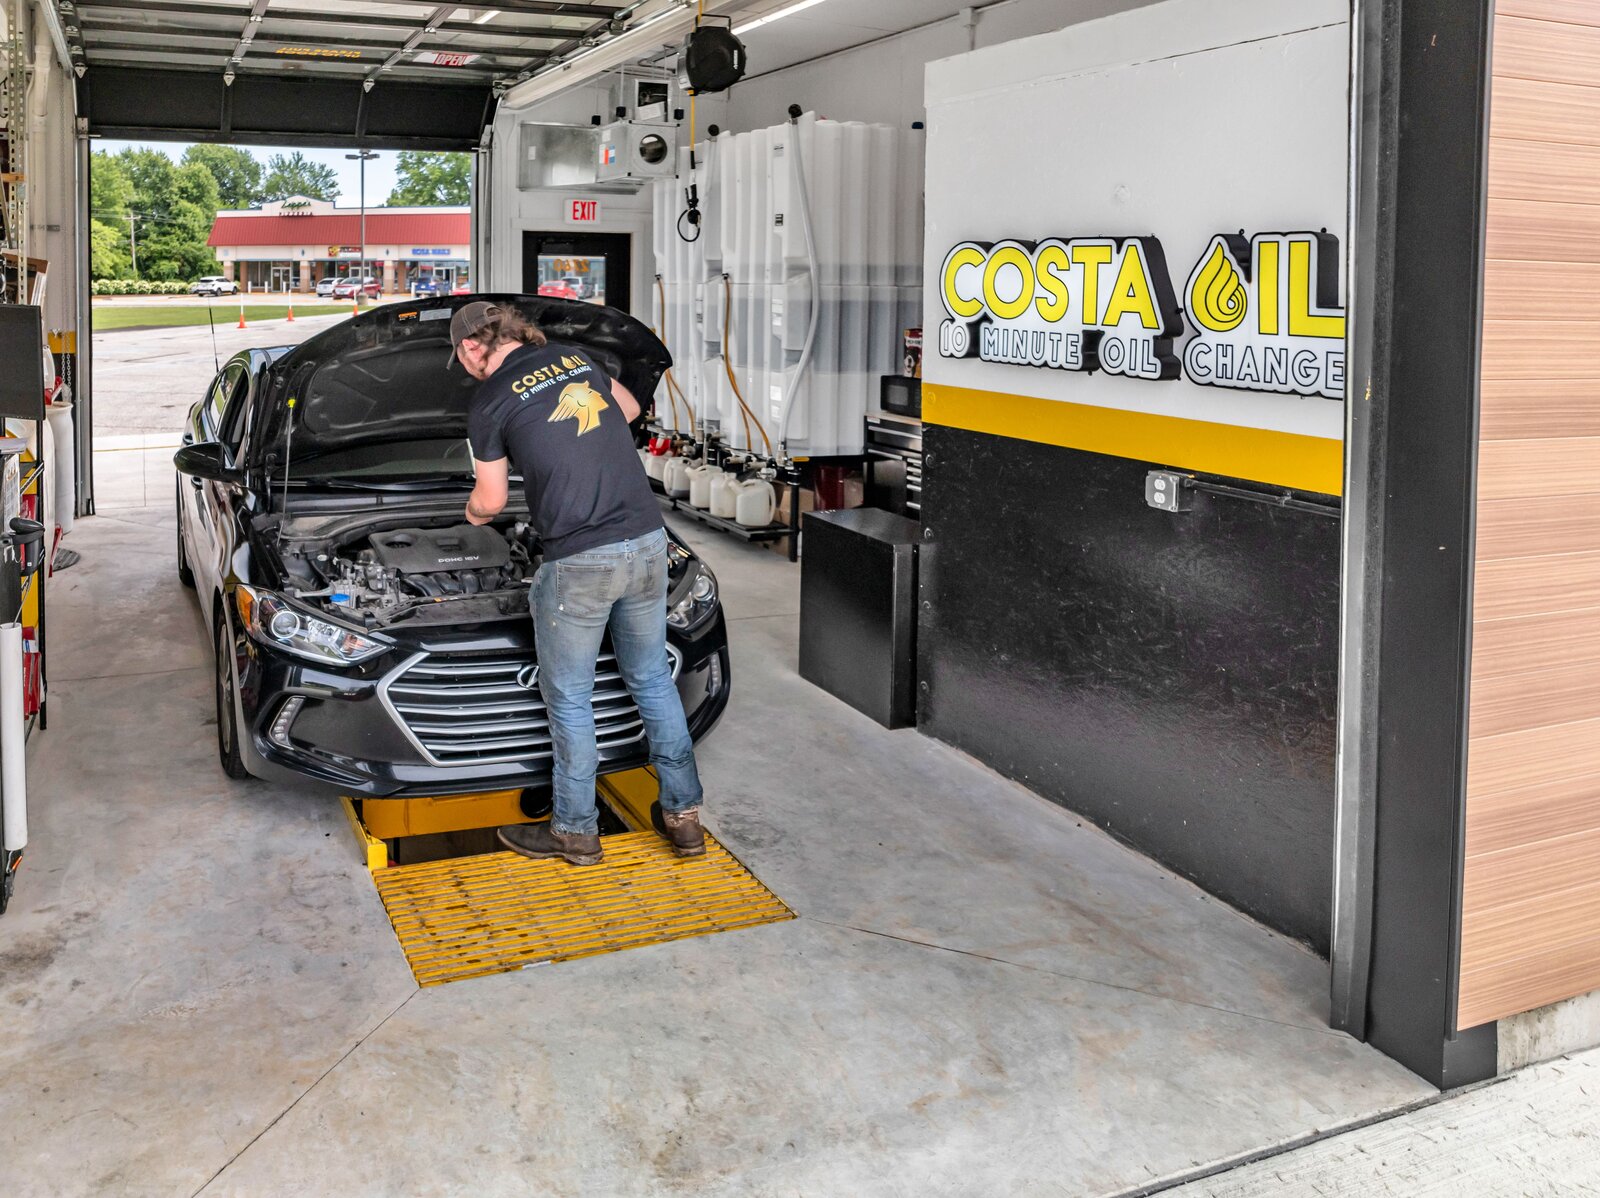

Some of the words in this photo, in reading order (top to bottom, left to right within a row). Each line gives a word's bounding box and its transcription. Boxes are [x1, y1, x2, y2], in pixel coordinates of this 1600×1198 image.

[435, 54, 466, 66] OPEN
[573, 201, 597, 220] EXIT
[945, 244, 1160, 329] COSTA
[943, 323, 967, 353] 10
[984, 328, 1080, 364] MINUTE
[1103, 336, 1158, 374] OIL
[1188, 342, 1344, 389] CHANGE
[512, 364, 564, 393] COSTA
[520, 392, 530, 401] 10
[530, 378, 556, 394] MINUTE
[556, 373, 569, 382] OIL
